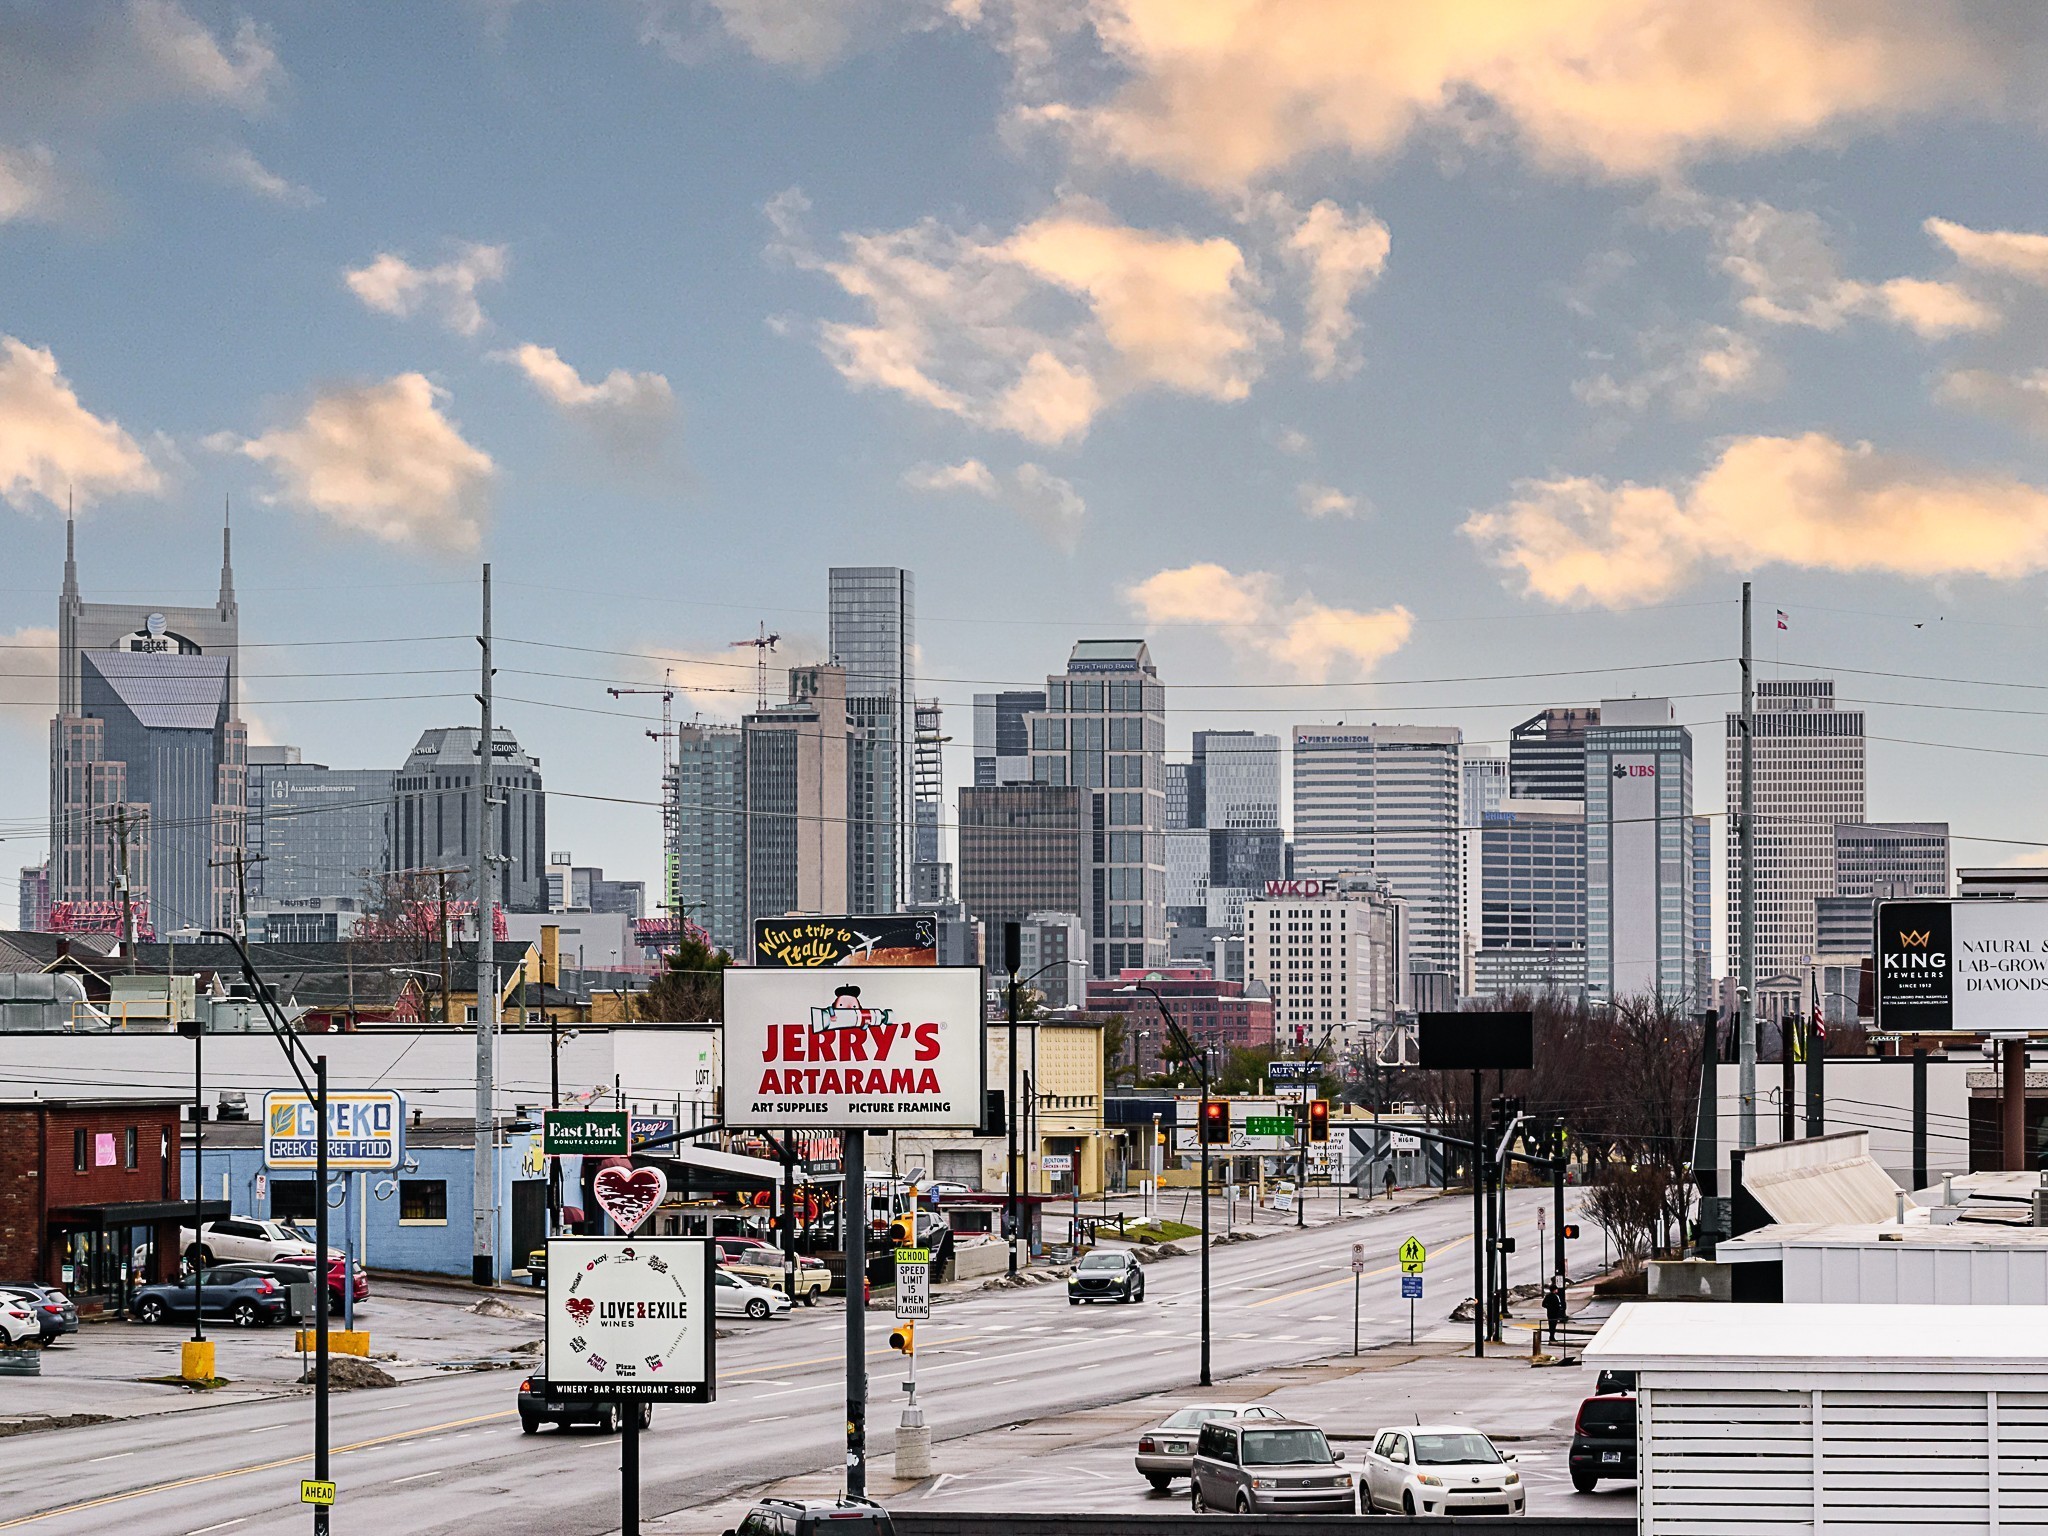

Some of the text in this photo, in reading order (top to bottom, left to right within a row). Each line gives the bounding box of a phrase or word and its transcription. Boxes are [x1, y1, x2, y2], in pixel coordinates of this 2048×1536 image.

[143, 639, 168, 652] at&t
[1308, 735, 1369, 743] FIRST HORIZON
[1629, 765, 1655, 777] UBS
[1484, 812, 1517, 822] PHILIPS
[1265, 879, 1339, 898] WKDF
[279, 899, 309, 907] TRUIST
[758, 924, 851, 956] Win a trip to
[1963, 939, 2036, 953] NATURAL
[777, 939, 838, 966] Italy
[1884, 952, 1947, 969] KING
[1887, 971, 1944, 979] JEWELERS
[1967, 977, 2048, 991] DIAMONDS
[761, 1022, 942, 1063] JERRY'S
[695, 1069, 710, 1085] LOFT
[758, 1068, 941, 1095] ARTARAMA
[750, 1102, 951, 1113] ART SUPPLIES PICTURE FRAMING
[549, 1122, 622, 1138] East Park
[272, 1140, 390, 1157] GREEK SREET FOOD
[898, 1251, 927, 1261] SCHOOL
[900, 1266, 925, 1275] SPEED
[902, 1275, 923, 1285] LIMIT
[908, 1285, 916, 1294] 15
[902, 1295, 924, 1304] WHEN
[897, 1305, 928, 1314] FLASHING
[600, 1320, 635, 1328] WINES
[586, 1357, 605, 1373] PUNCH
[590, 1352, 608, 1367] PARTY
[556, 1385, 697, 1394] WINERY BAR RESTAURANT SHOP
[305, 1486, 333, 1499] AHEAD
